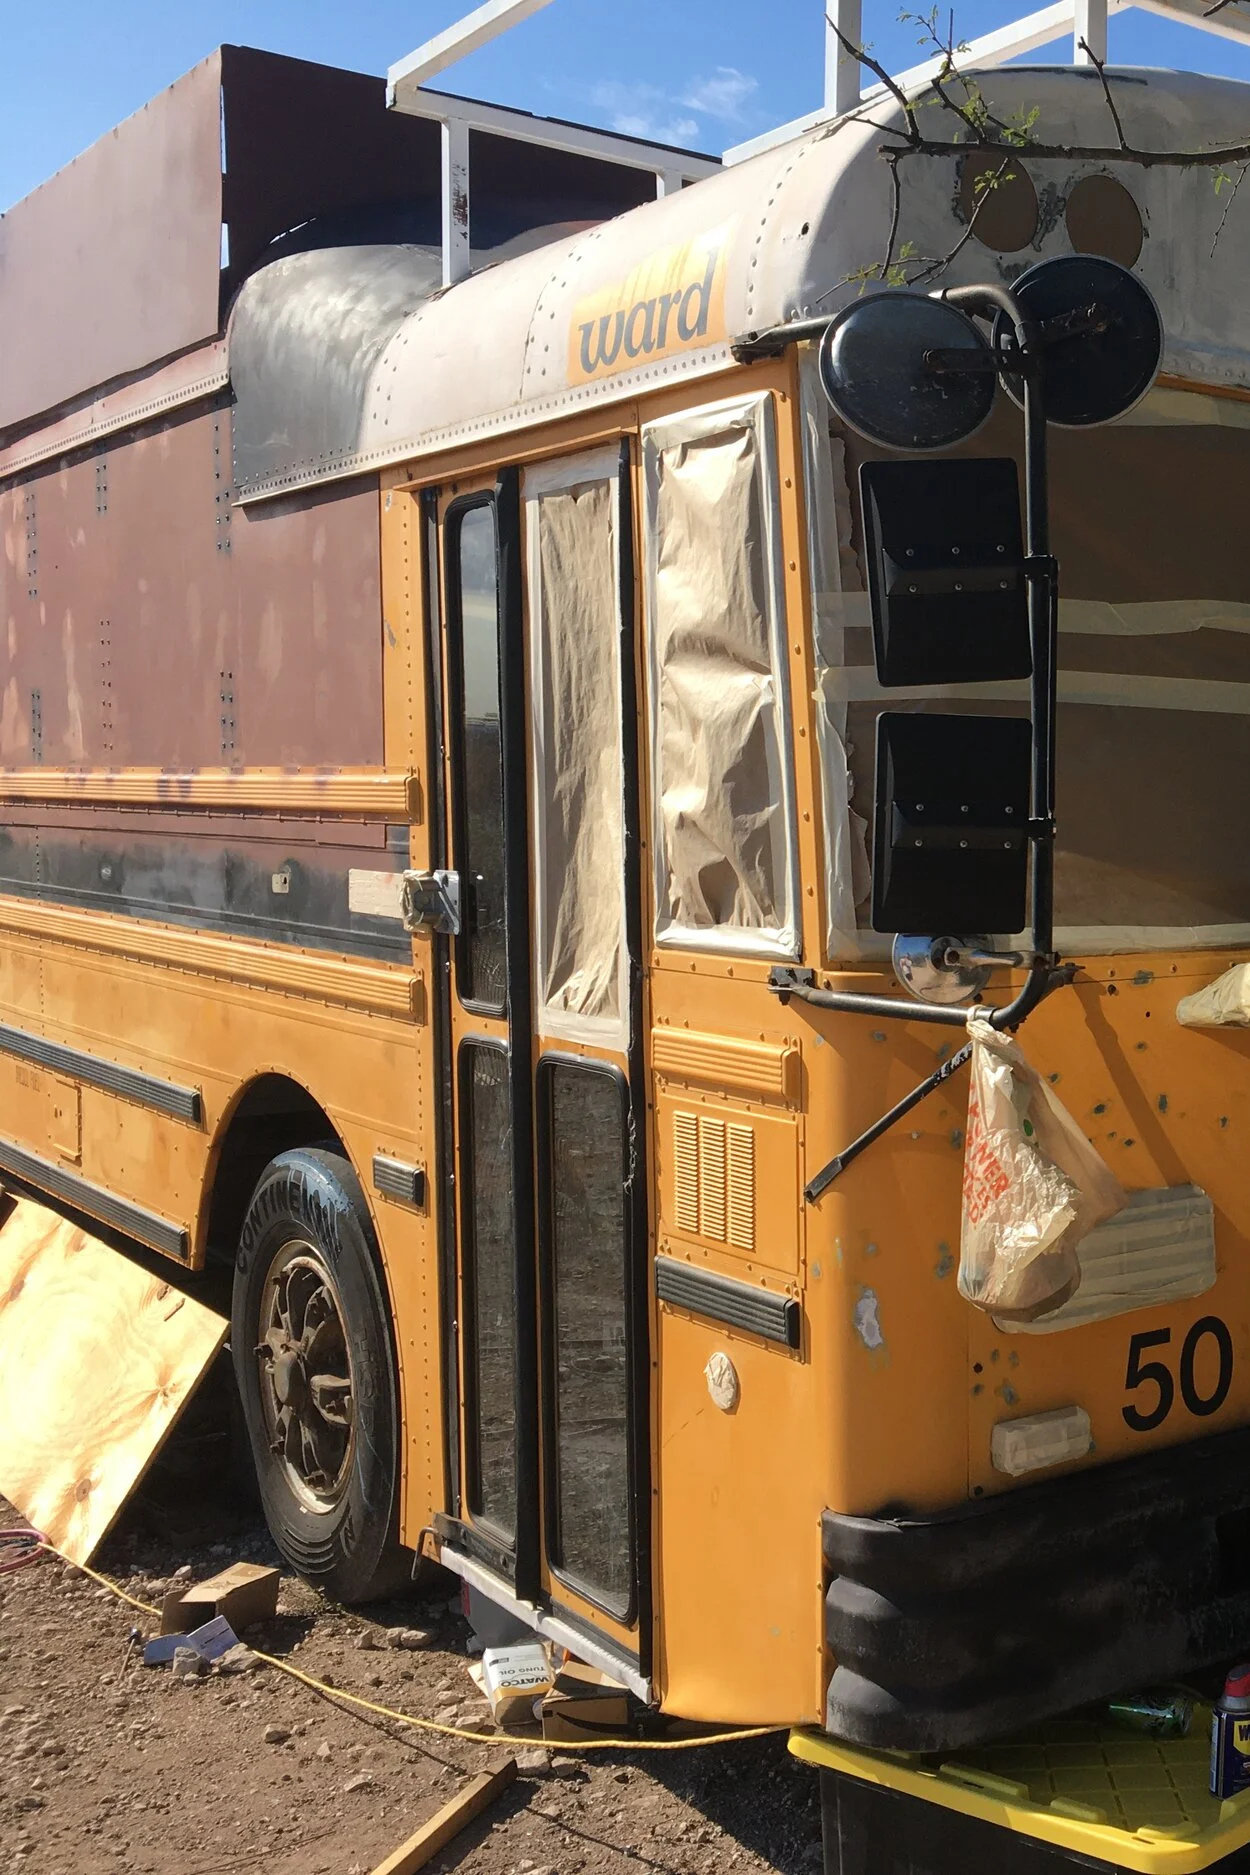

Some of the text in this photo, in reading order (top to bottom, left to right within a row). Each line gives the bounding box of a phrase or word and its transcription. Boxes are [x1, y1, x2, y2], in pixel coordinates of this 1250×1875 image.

[579, 247, 718, 373] ward
[1121, 1315, 1234, 1431] 50
[501, 1676, 549, 1688] WATCO
